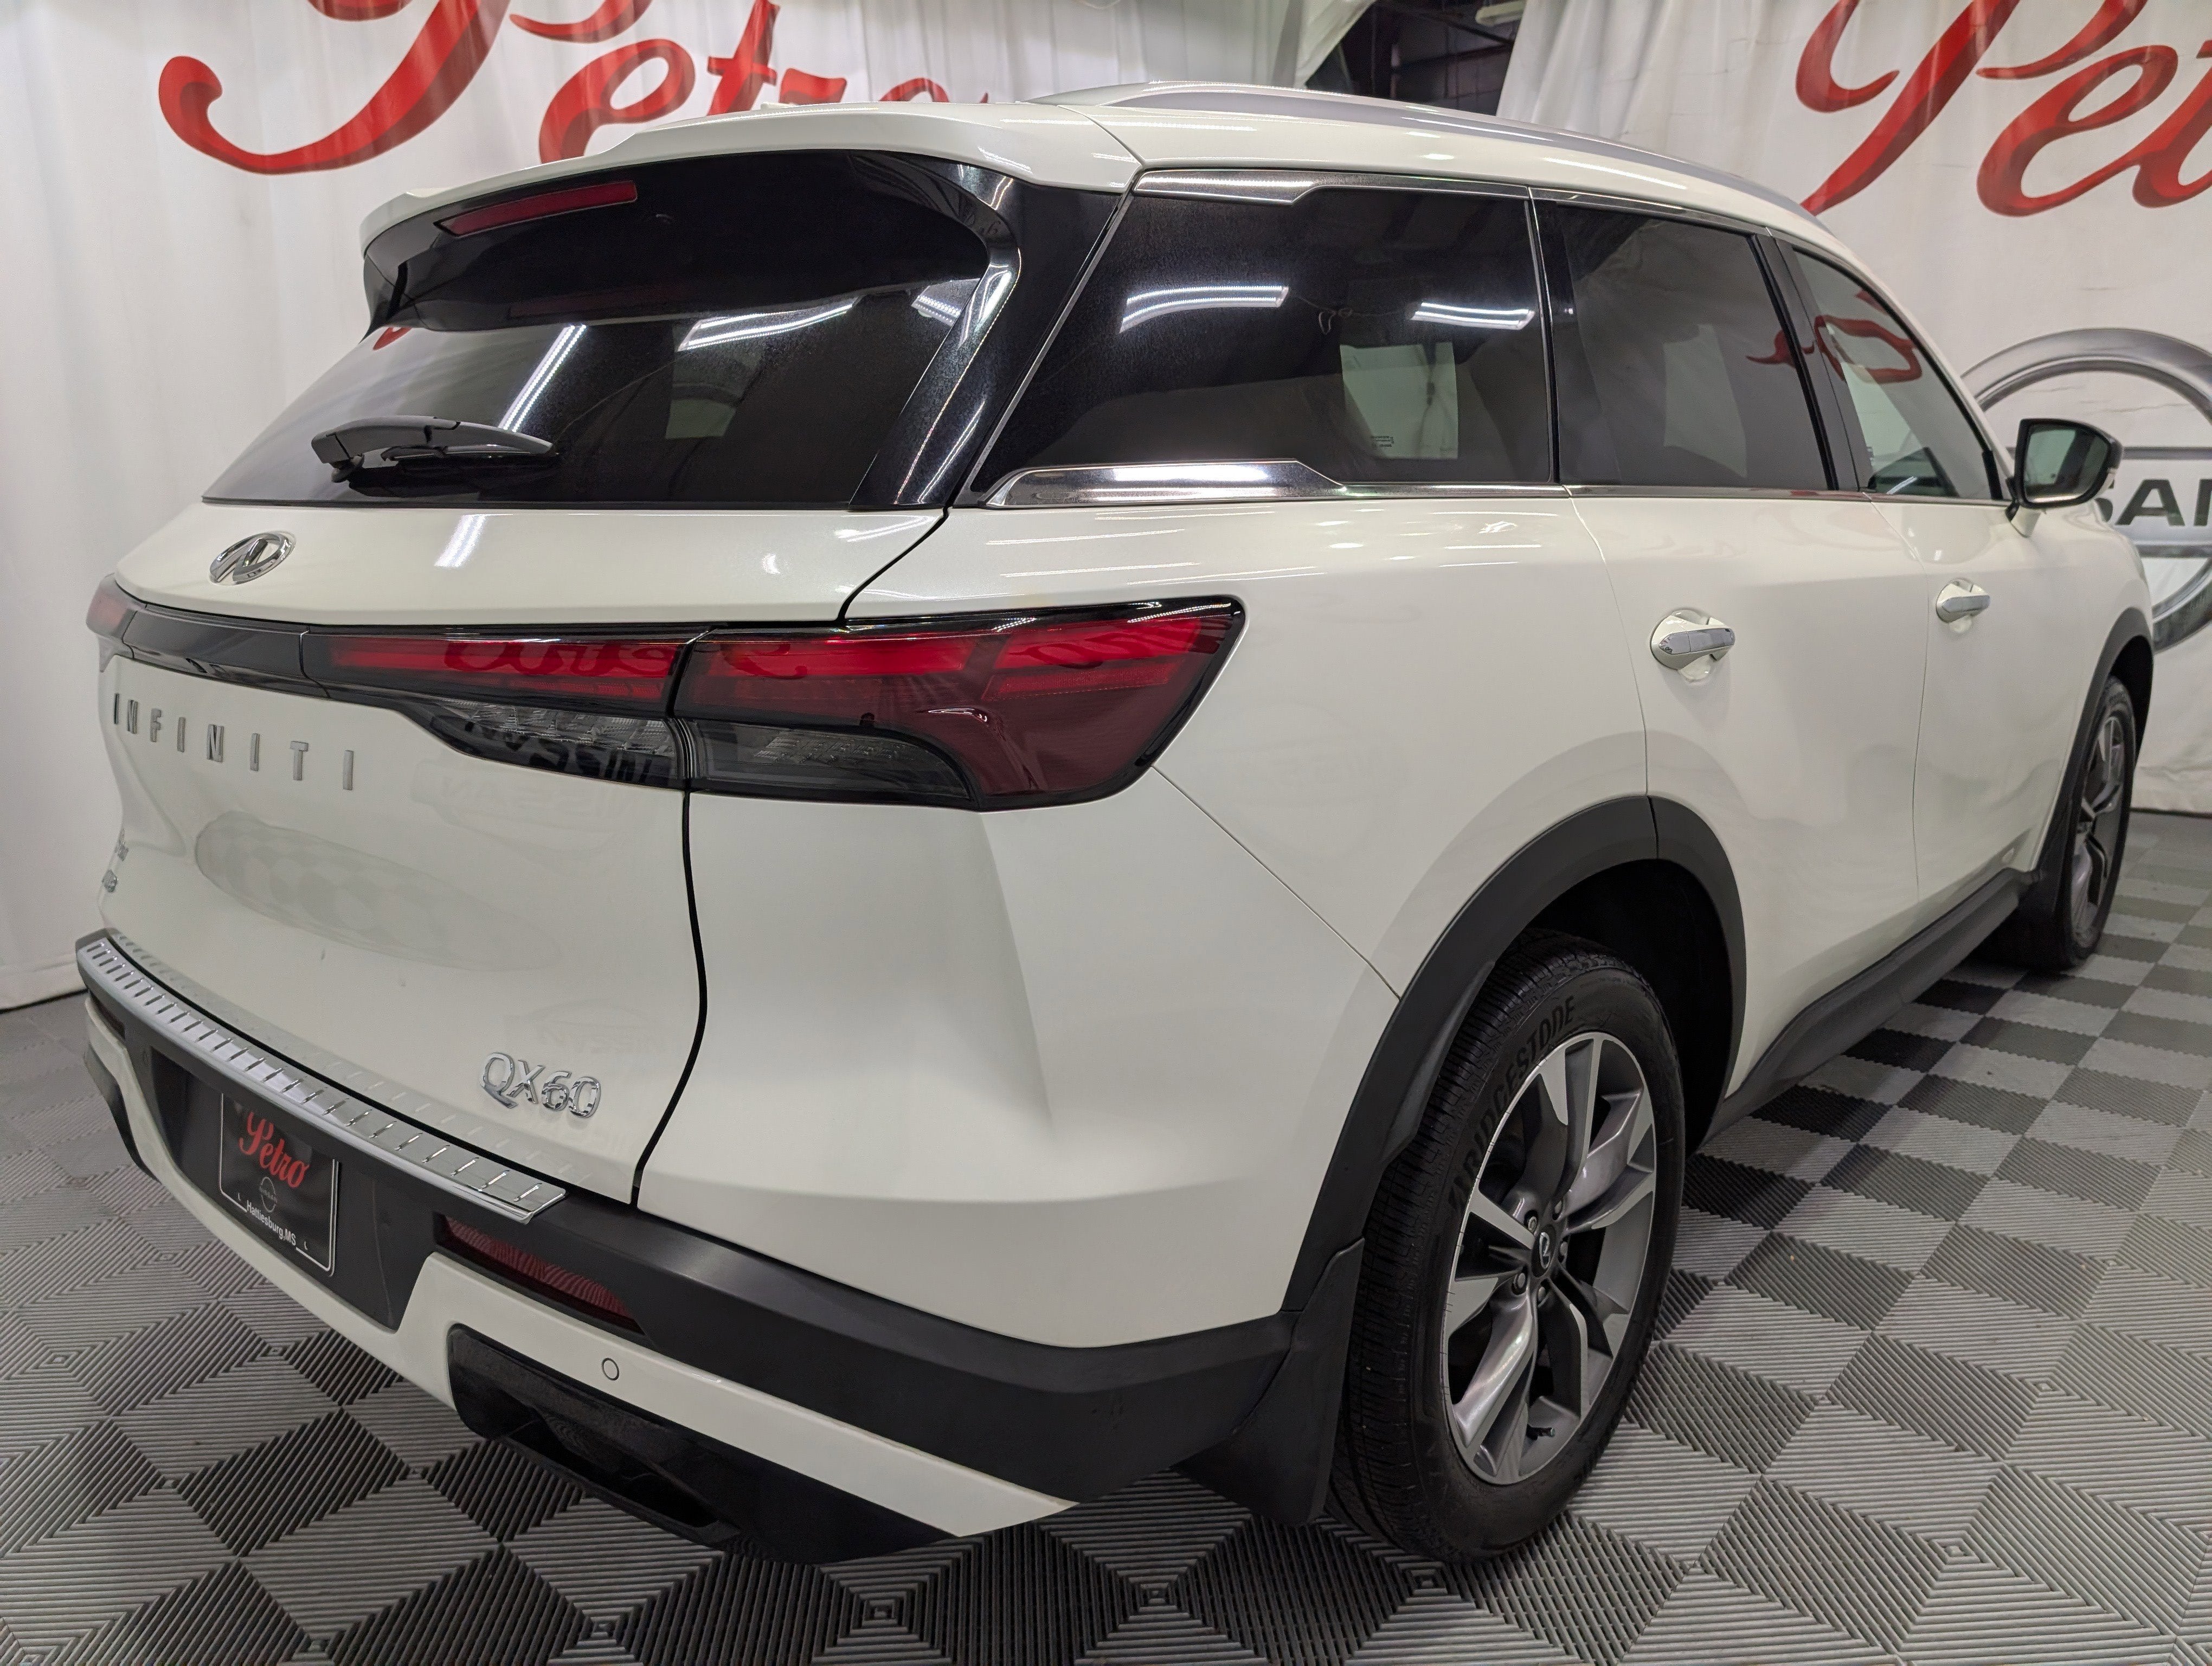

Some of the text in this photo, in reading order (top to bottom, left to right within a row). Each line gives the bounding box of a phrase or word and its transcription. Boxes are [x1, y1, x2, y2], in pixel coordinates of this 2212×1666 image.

[113, 693, 354, 791] INFINITI
[479, 1052, 601, 1118] QX60
[239, 1111, 310, 1188] Petro
